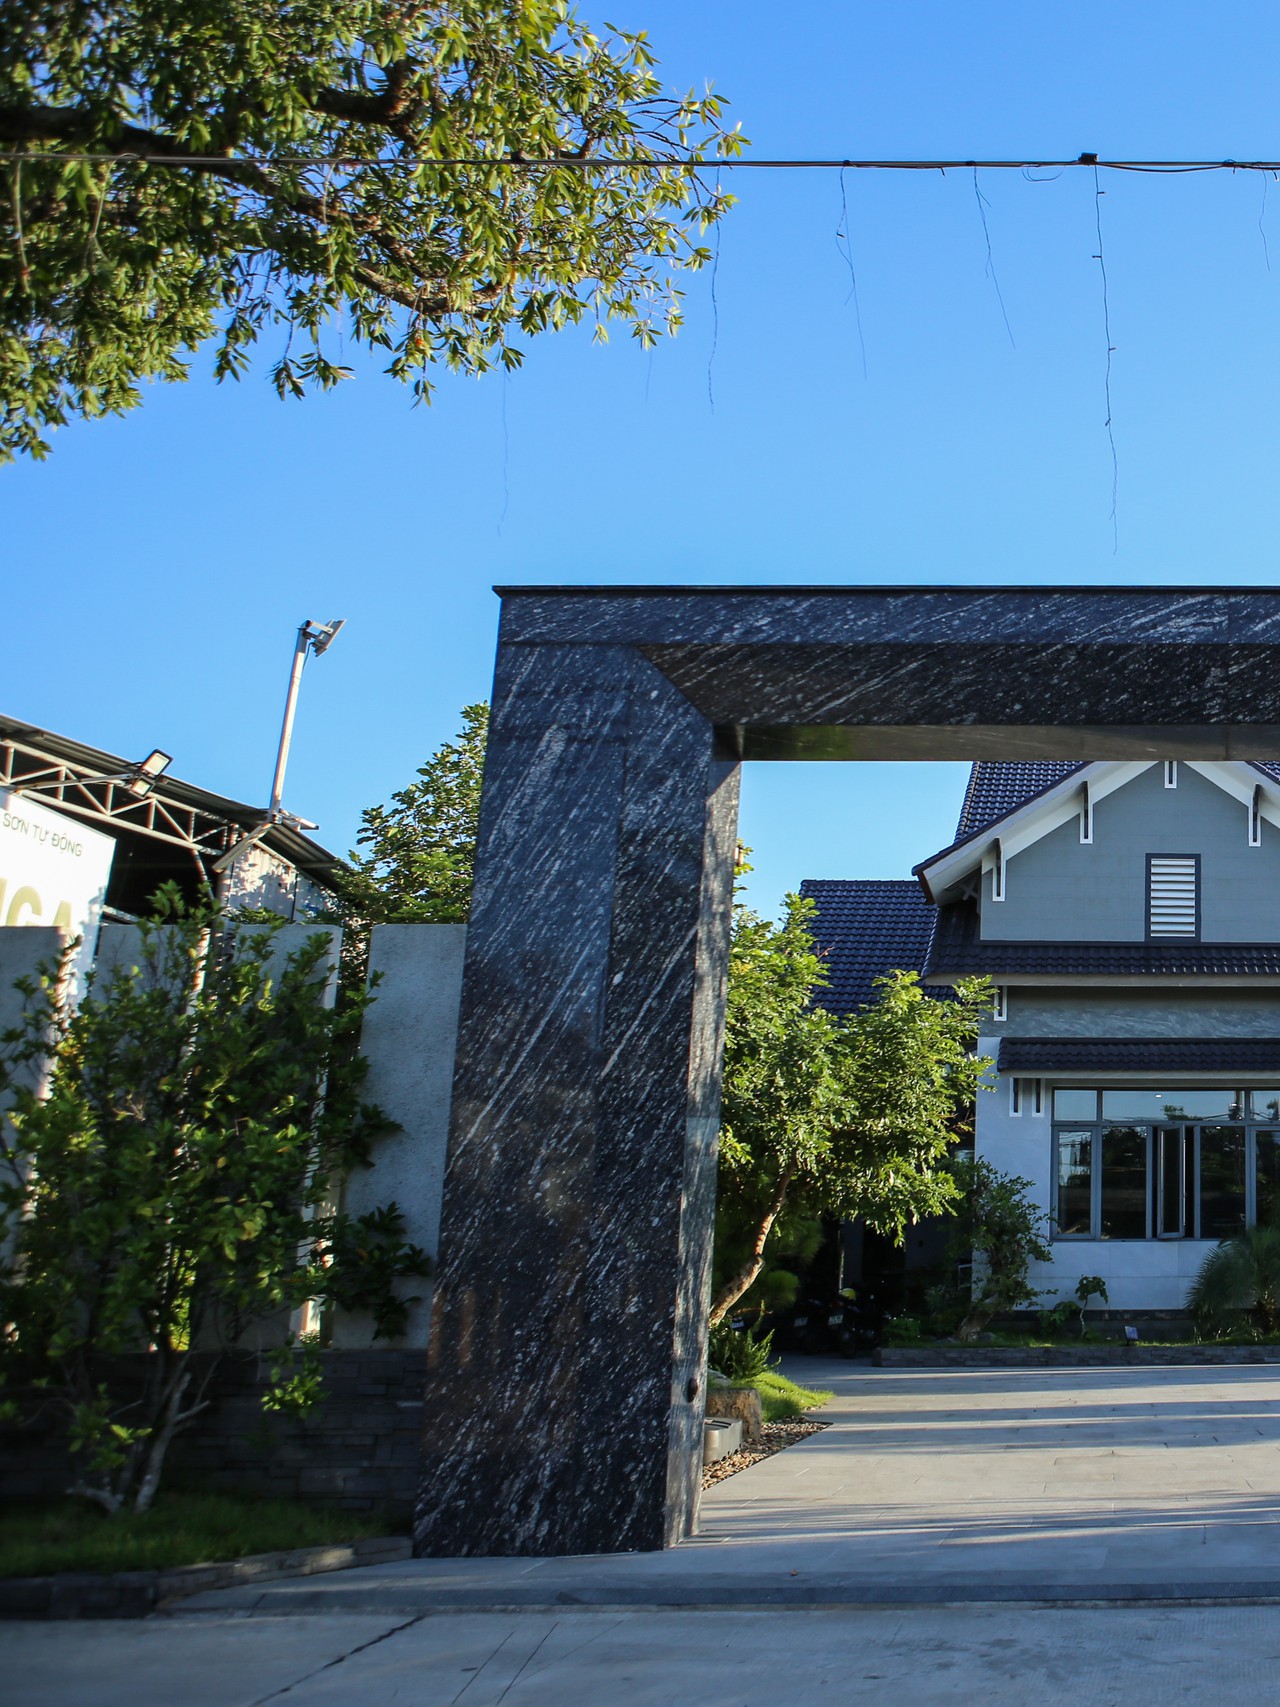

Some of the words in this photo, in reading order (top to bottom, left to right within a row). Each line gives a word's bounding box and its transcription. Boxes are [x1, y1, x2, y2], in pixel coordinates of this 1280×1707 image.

[3, 812, 29, 835] SƠN
[33, 824, 49, 846] TỰ
[51, 832, 82, 857] ĐỘNG
